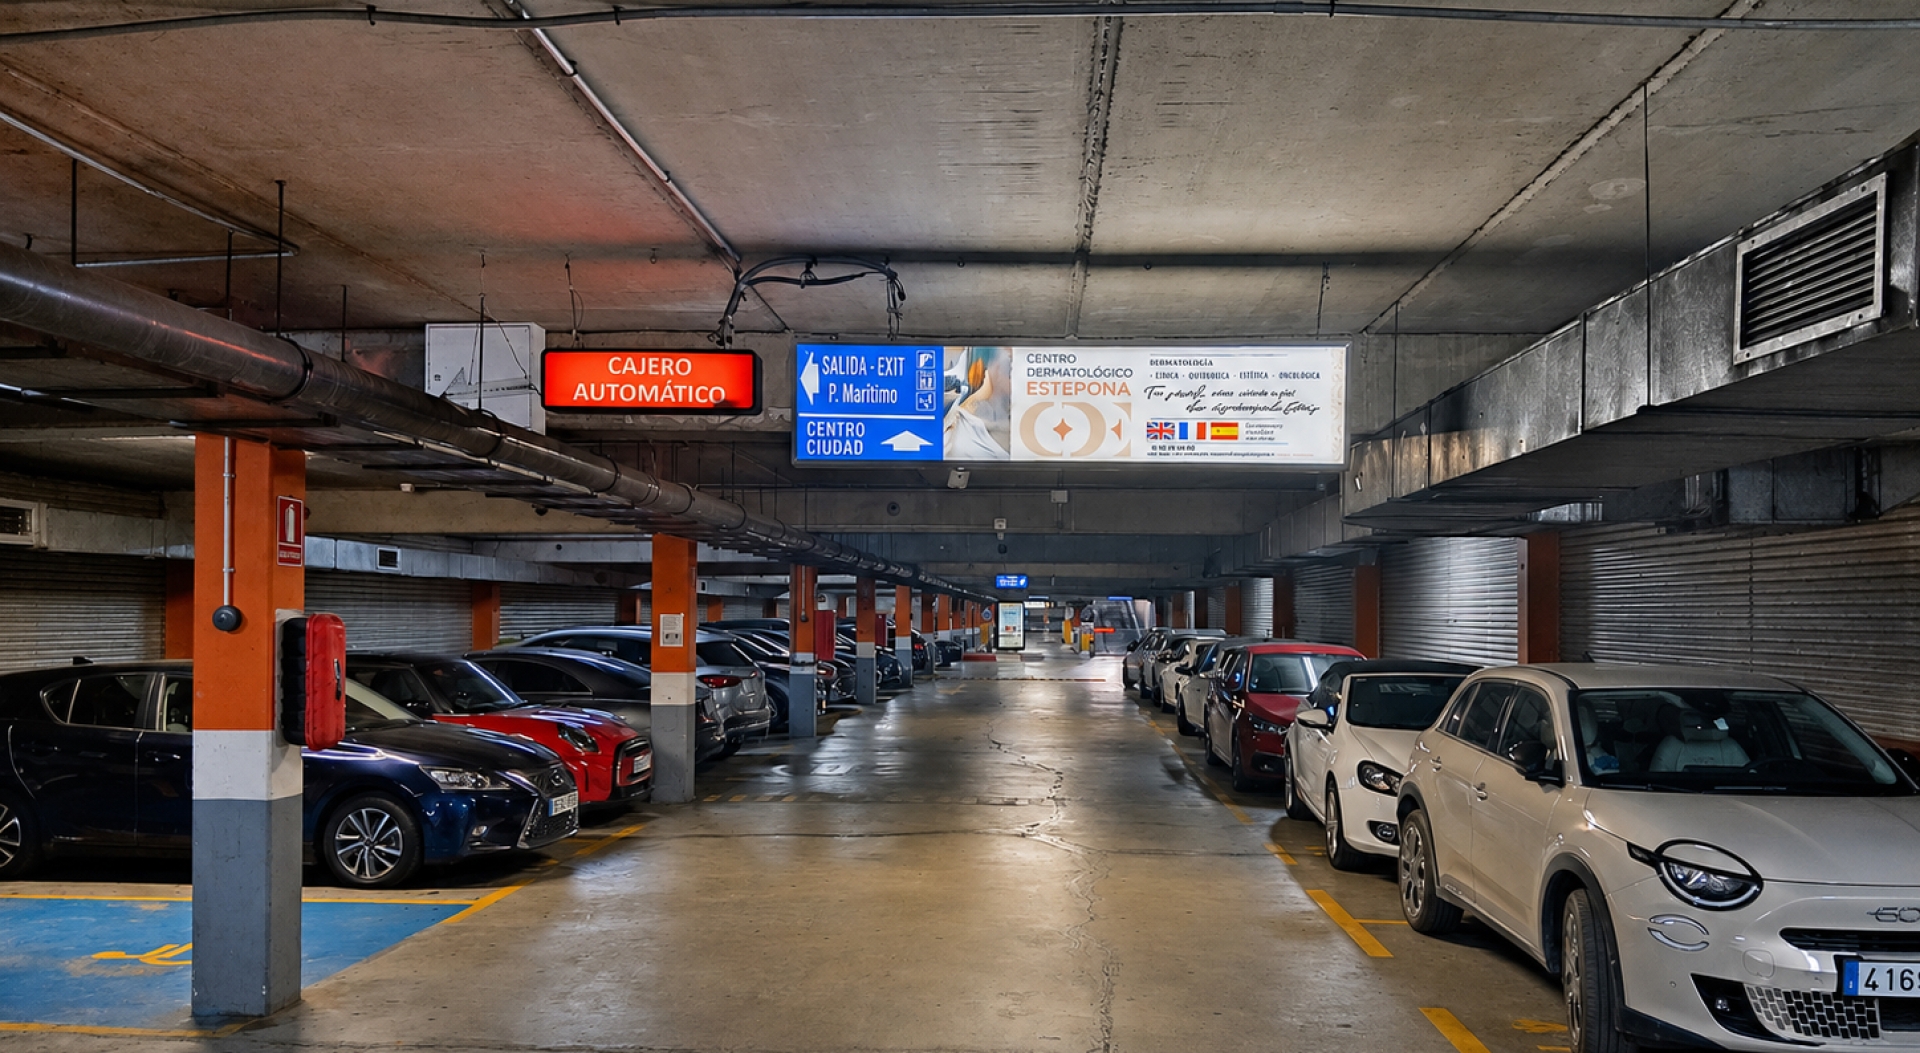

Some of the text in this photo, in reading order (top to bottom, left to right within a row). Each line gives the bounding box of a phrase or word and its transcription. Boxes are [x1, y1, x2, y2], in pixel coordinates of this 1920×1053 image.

[608, 357, 692, 376] CAJERO
[822, 355, 867, 376] SALIDA
[877, 357, 905, 377] EXIT
[1026, 353, 1077, 364] CENTRO
[1026, 365, 1134, 378] DERMATOLÓGICO
[573, 380, 726, 404] AUTOMÁTICO
[828, 382, 839, 403] P.
[1026, 381, 1132, 396] ESTEPONA
[806, 421, 866, 437] CENTRO
[806, 439, 864, 455] CIUDAD
[1864, 967, 1920, 992] 416
